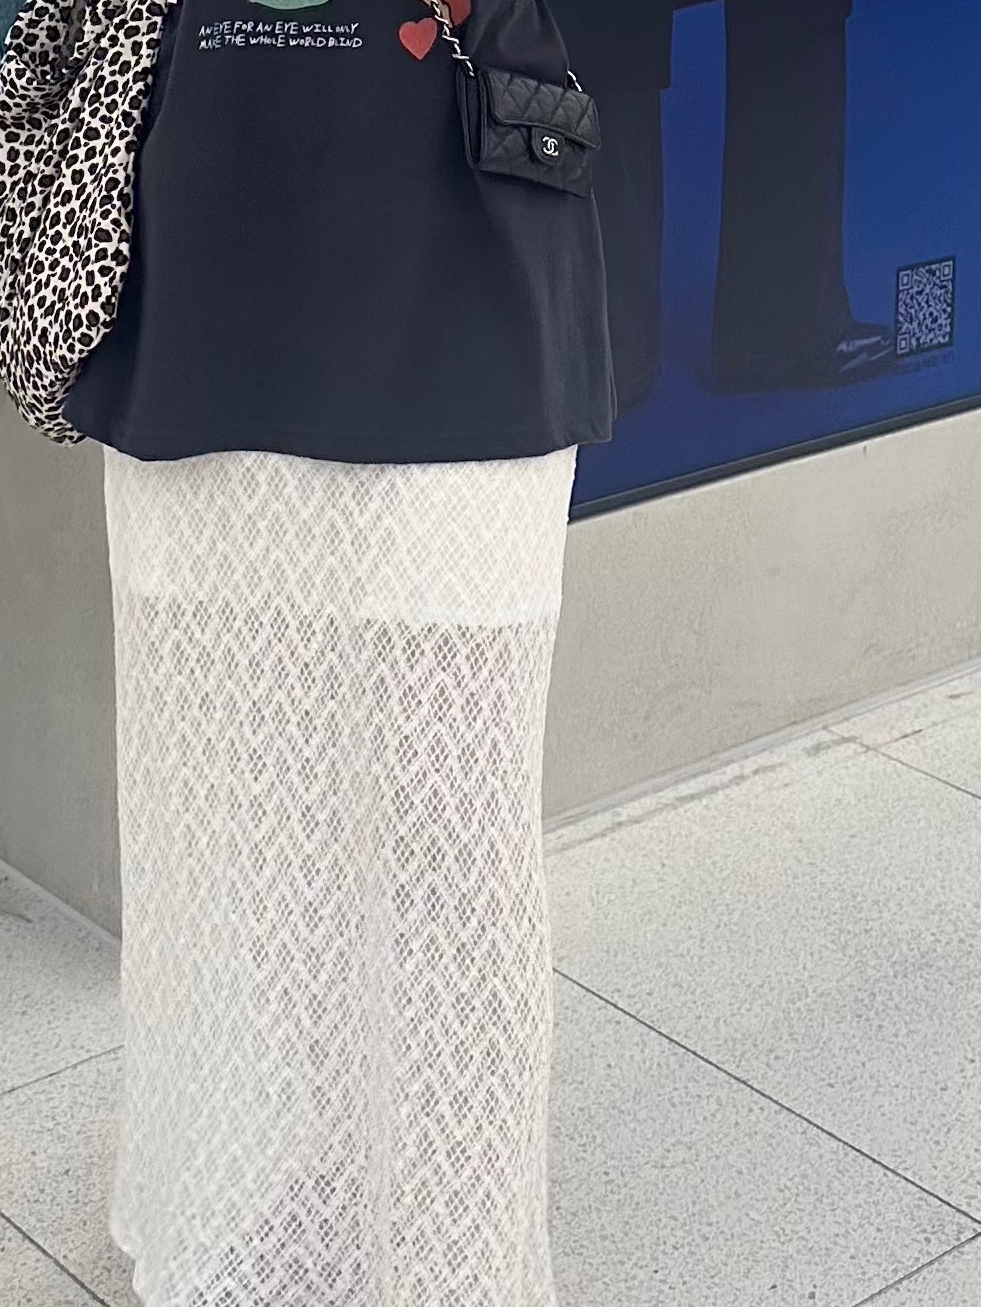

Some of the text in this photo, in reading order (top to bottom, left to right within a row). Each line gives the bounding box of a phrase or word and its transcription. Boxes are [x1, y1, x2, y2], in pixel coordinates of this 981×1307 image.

[198, 25, 214, 37] AN
[232, 20, 255, 35] FOR
[255, 21, 274, 34] AN
[274, 20, 299, 35] EYE
[301, 23, 334, 34] WILL
[224, 33, 246, 47] THE
[249, 34, 286, 47] WHOLE
[288, 35, 327, 48] WORLD
[327, 36, 364, 48] BLIND
